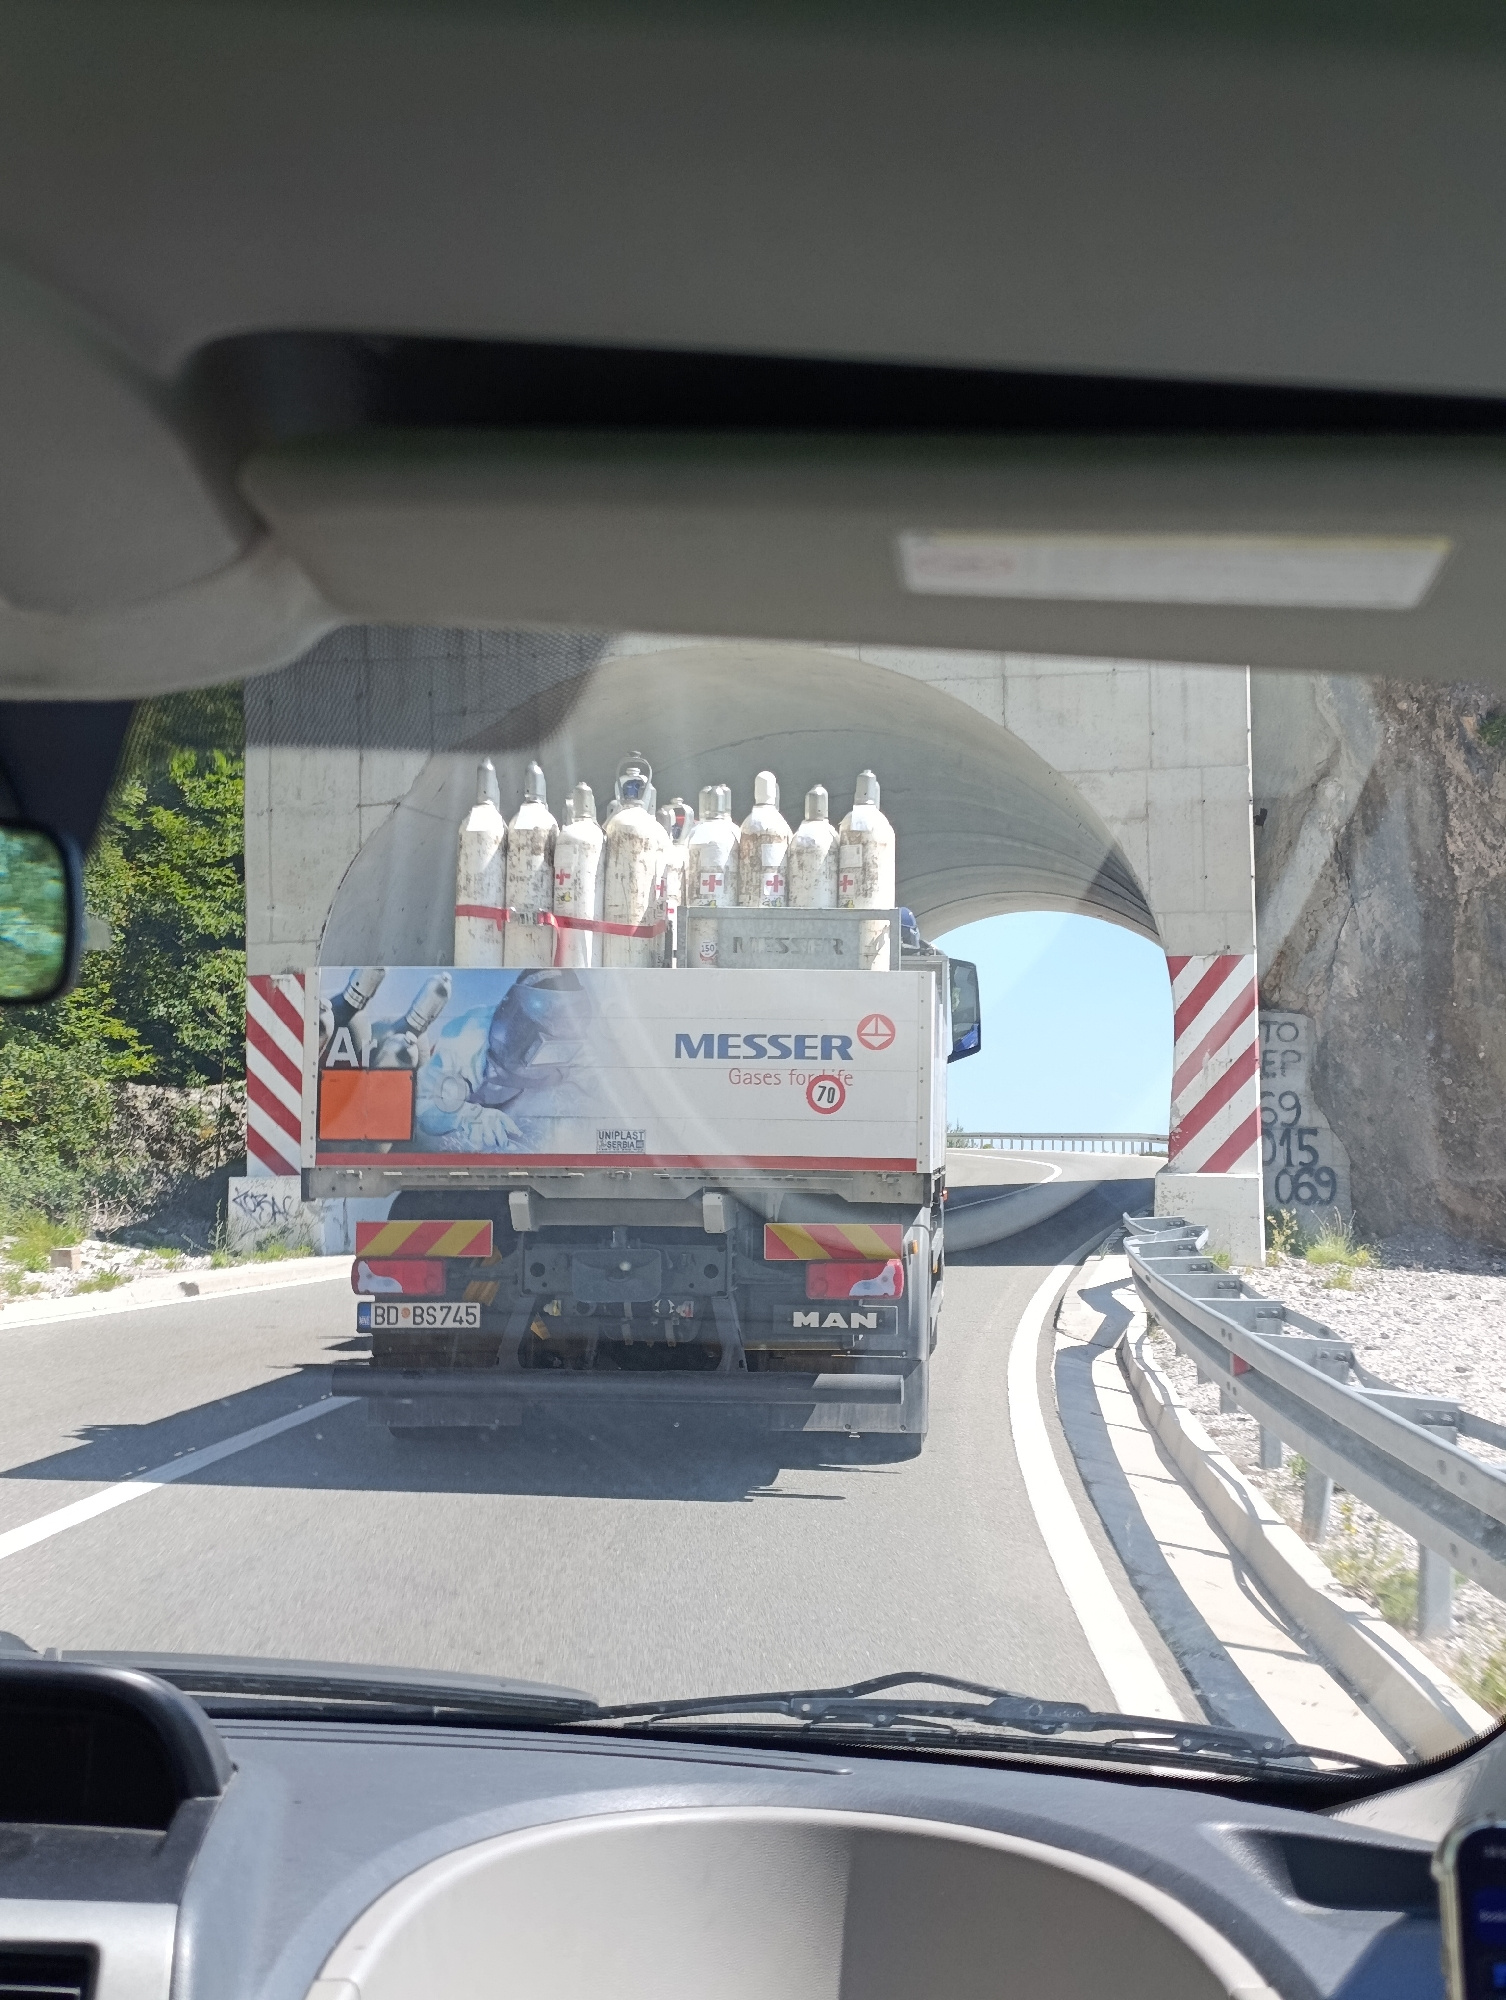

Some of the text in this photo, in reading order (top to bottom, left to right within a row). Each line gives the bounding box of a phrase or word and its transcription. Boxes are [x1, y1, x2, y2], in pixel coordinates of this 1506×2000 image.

[325, 1026, 378, 1068] Ar
[674, 1033, 854, 1061] MESSER
[728, 1067, 782, 1086] Gases
[817, 1085, 836, 1104] 70
[598, 1130, 645, 1140] UNIPLAST
[606, 1140, 635, 1149] SERBIA
[1274, 1166, 1337, 1205] 069
[374, 1305, 399, 1326] BD
[412, 1305, 477, 1326] BS745
[793, 1311, 878, 1329] MAN
